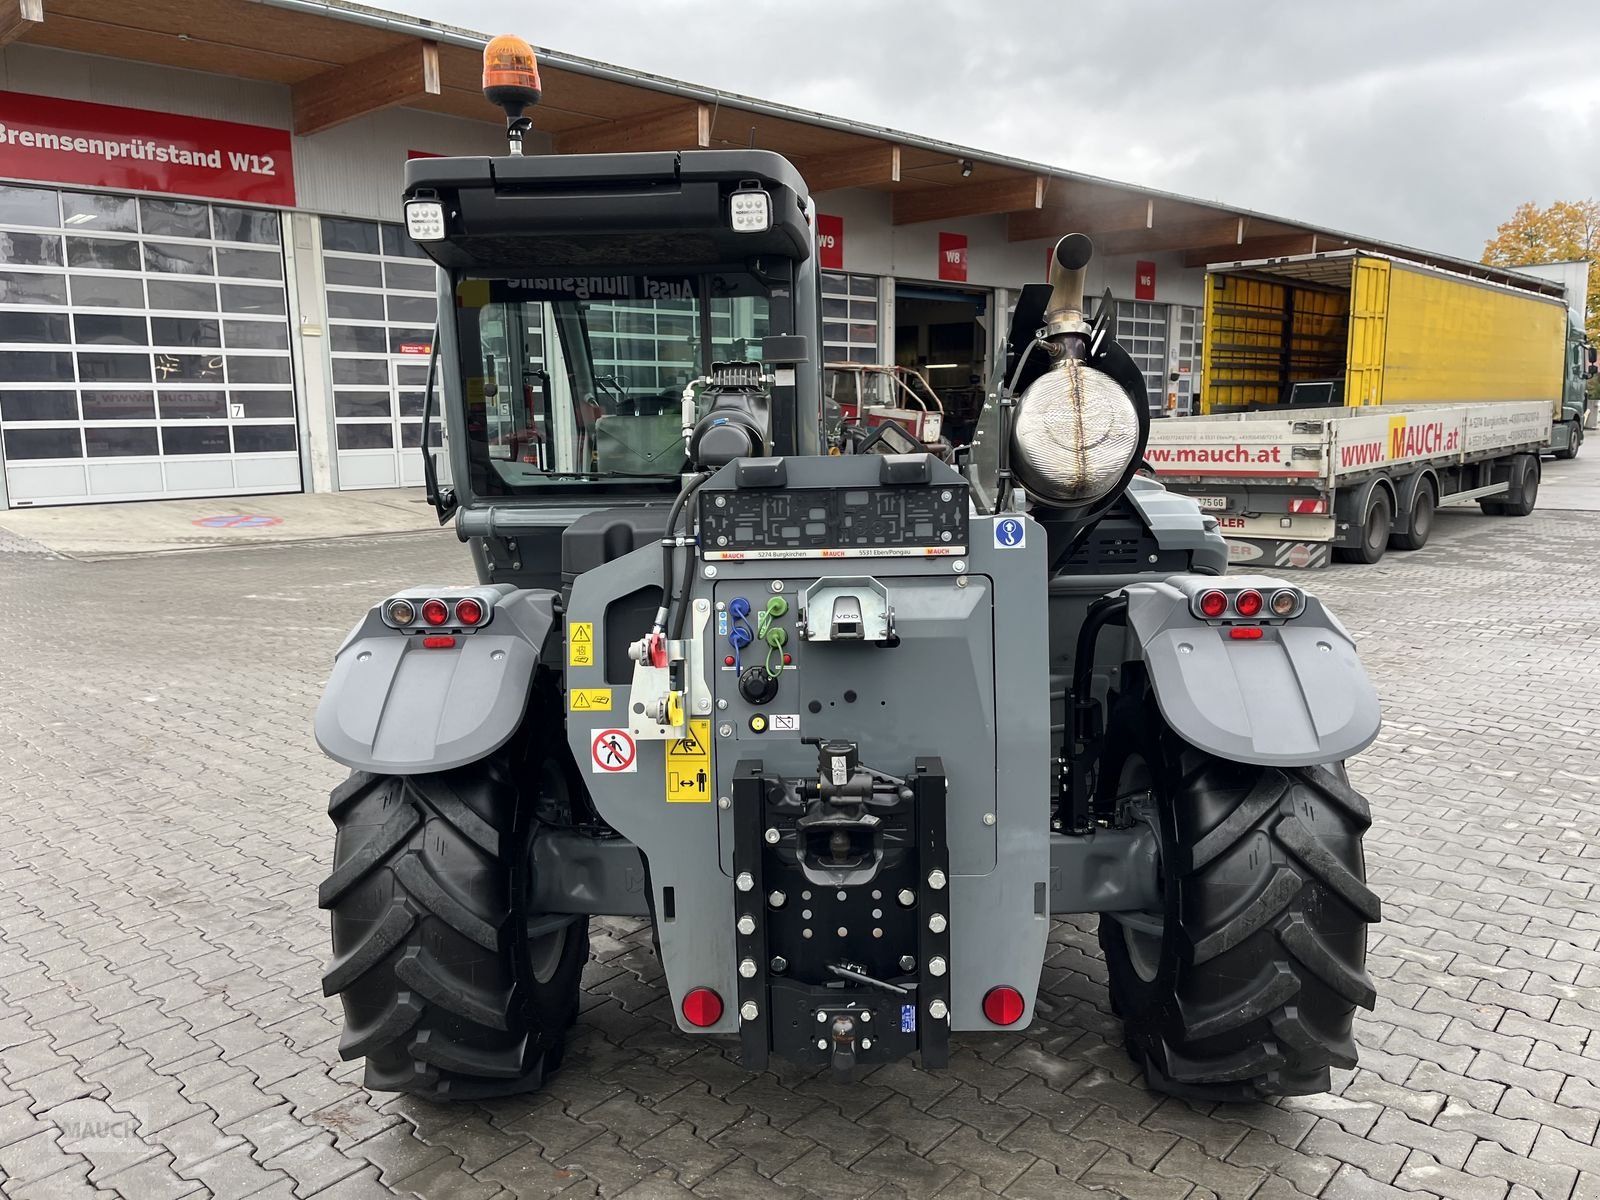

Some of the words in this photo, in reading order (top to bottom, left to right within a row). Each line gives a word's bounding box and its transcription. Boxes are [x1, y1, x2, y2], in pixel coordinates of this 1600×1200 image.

[228, 151, 275, 176] W12
[818, 234, 834, 248] W9
[946, 251, 960, 264] W8
[1140, 275, 1151, 286] W6
[233, 406, 241, 417] 7
[1214, 498, 1224, 507] GG
[772, 551, 807, 559] Burgkirchen
